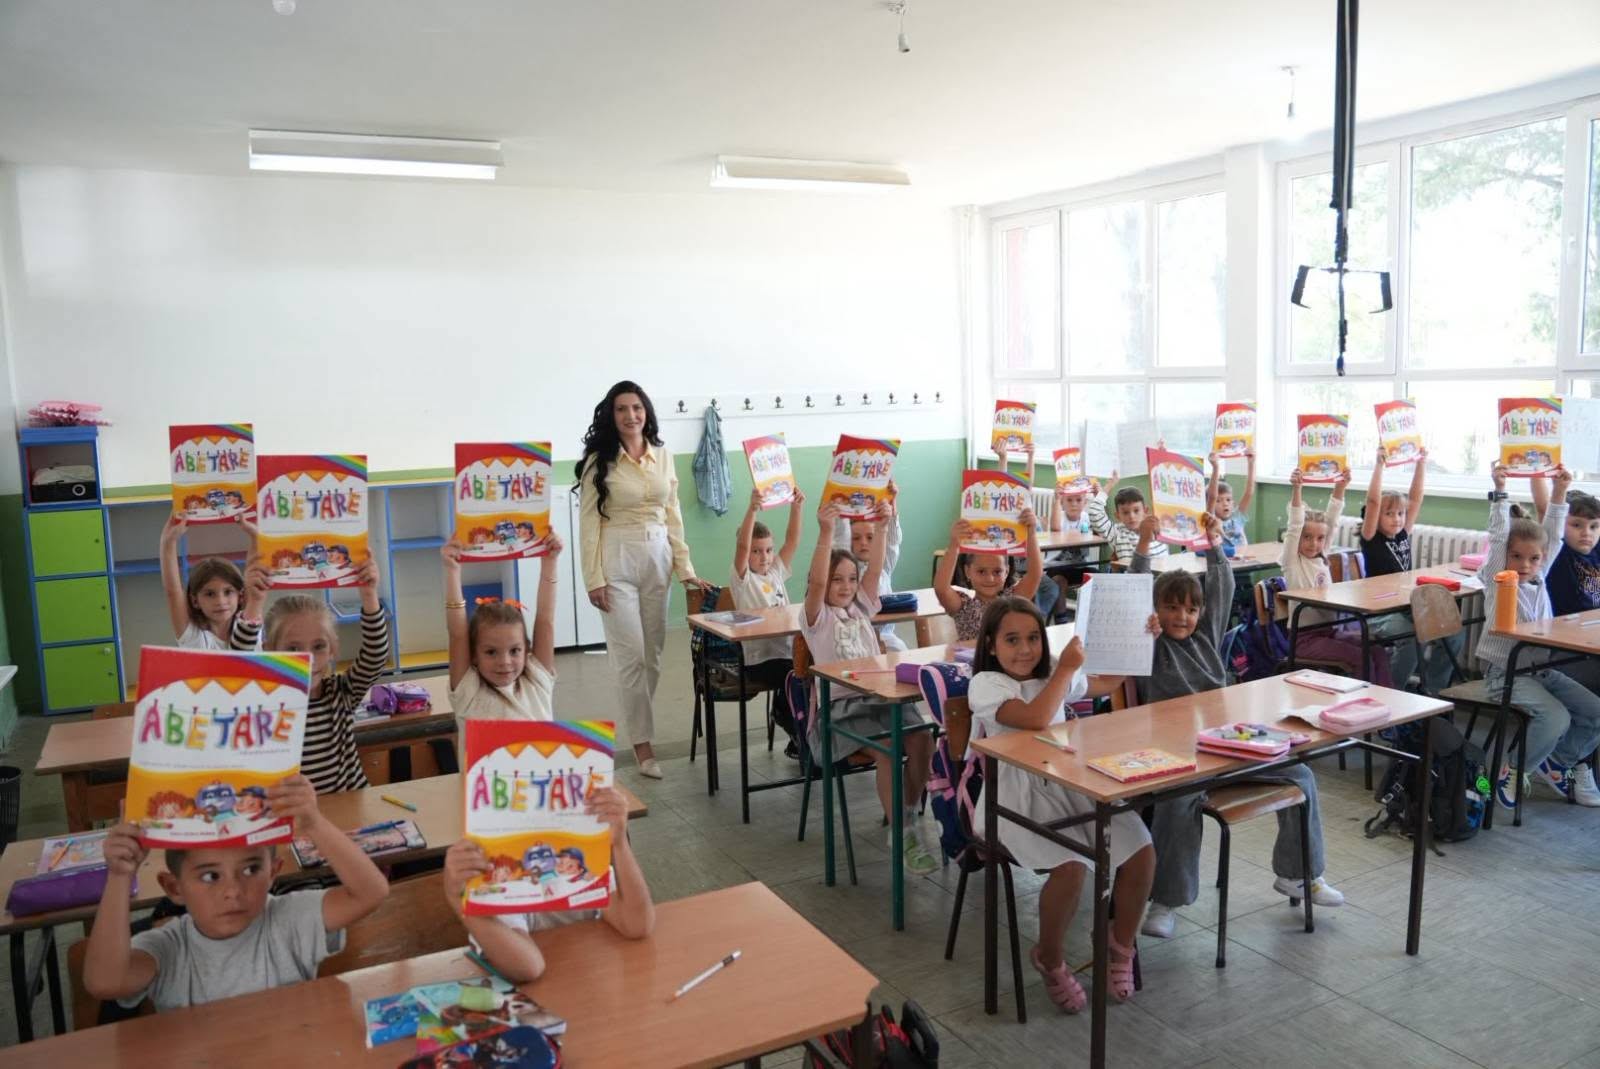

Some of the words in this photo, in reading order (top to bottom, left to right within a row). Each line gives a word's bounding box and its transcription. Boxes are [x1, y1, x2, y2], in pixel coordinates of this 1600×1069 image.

[1300, 431, 1345, 448] ABETARE
[1502, 418, 1558, 436] ABETARE
[174, 448, 249, 474] ABETARE
[833, 456, 892, 479] ABETARE
[460, 475, 545, 502] ABETARE
[1153, 470, 1203, 498] ABETARE
[261, 490, 361, 521] ABETARE
[964, 491, 1025, 512] ABETARE
[139, 702, 296, 750] ABETARE
